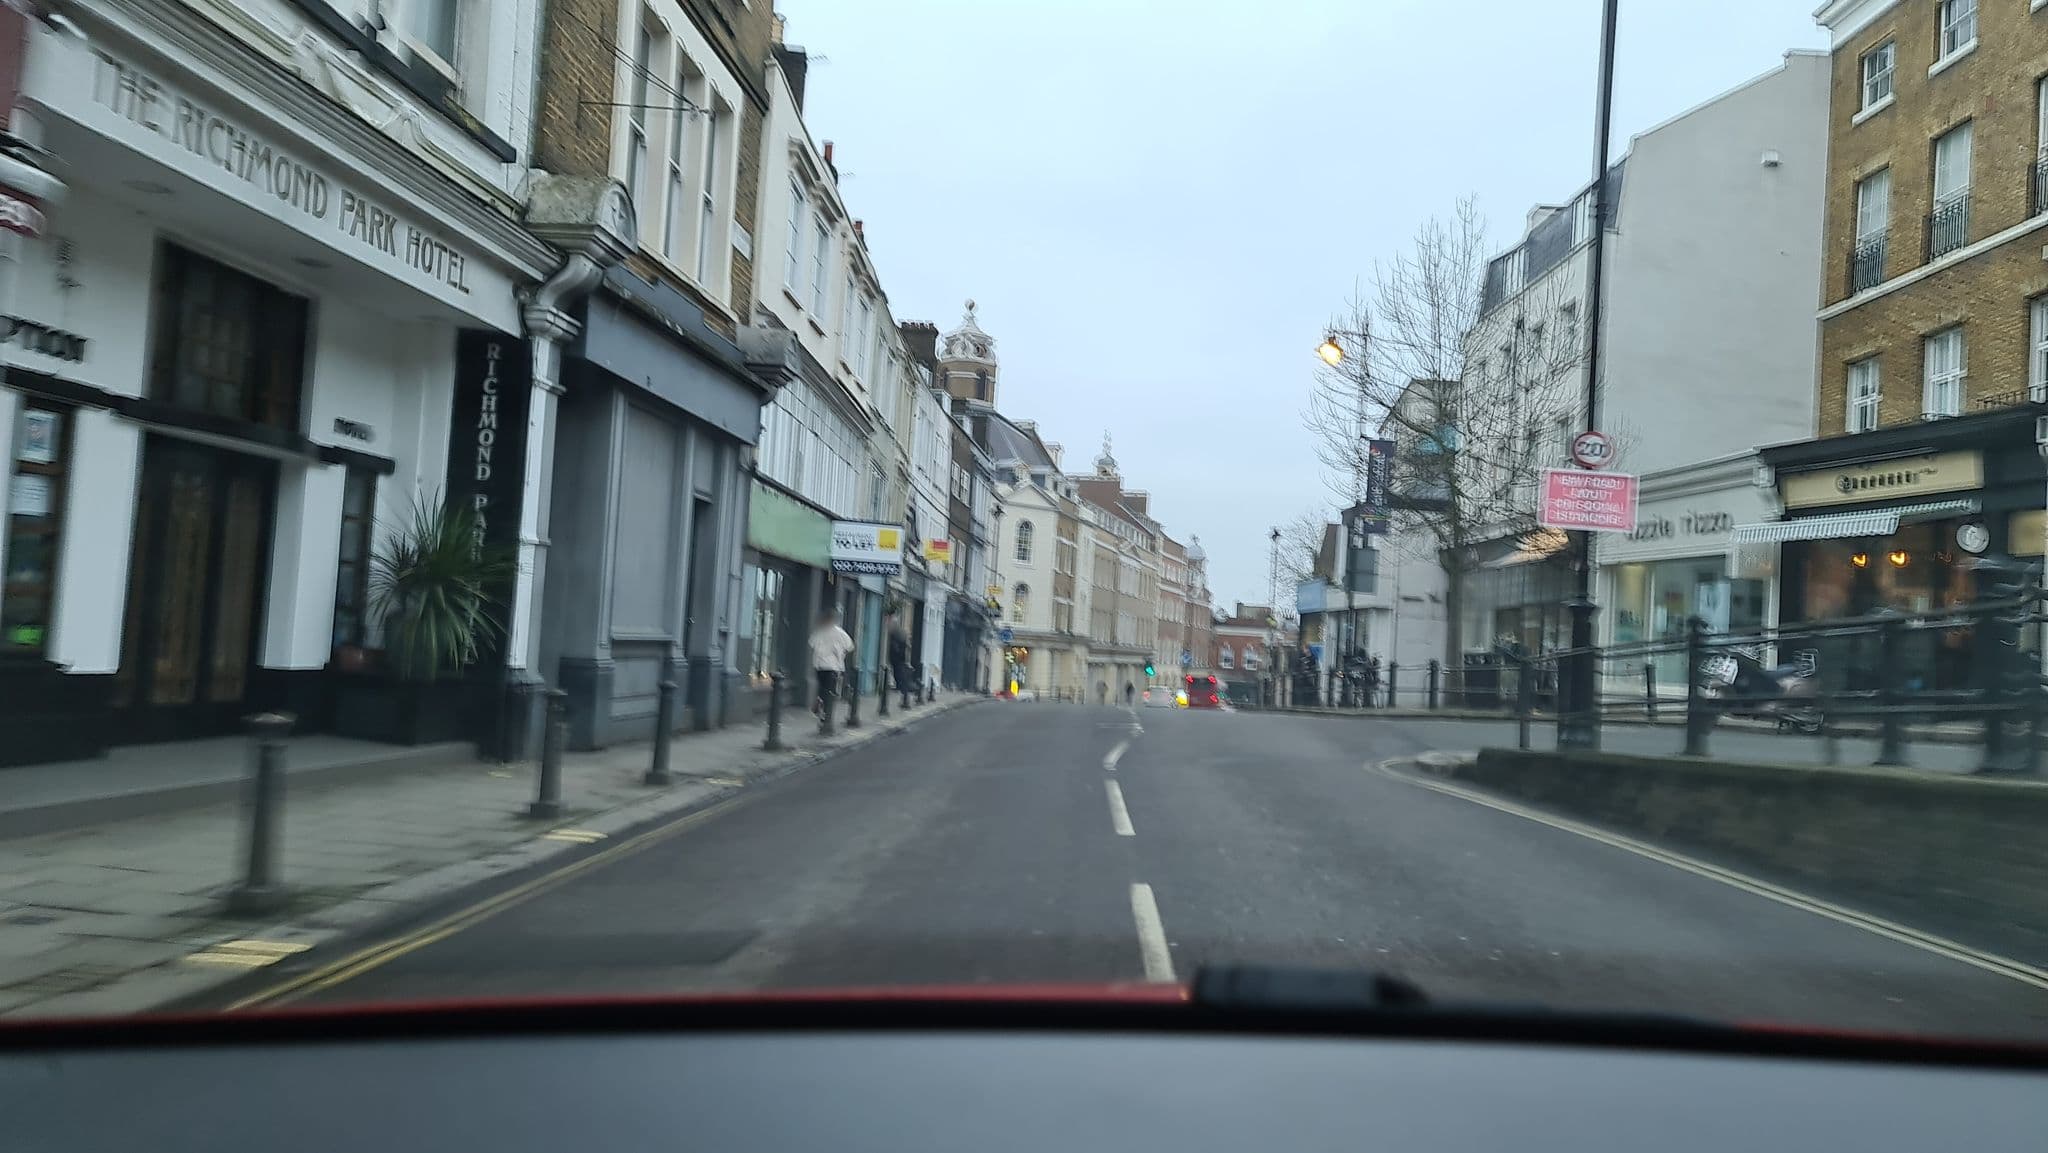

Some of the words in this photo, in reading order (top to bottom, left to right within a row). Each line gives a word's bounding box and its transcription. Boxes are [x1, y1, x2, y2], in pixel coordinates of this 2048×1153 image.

[93, 52, 162, 134] THE
[171, 96, 328, 219] RICHMOND
[338, 188, 398, 257] PARK
[406, 225, 470, 294] HOTEL
[474, 342, 502, 481] RICHMOND
[1576, 441, 1607, 459] 20
